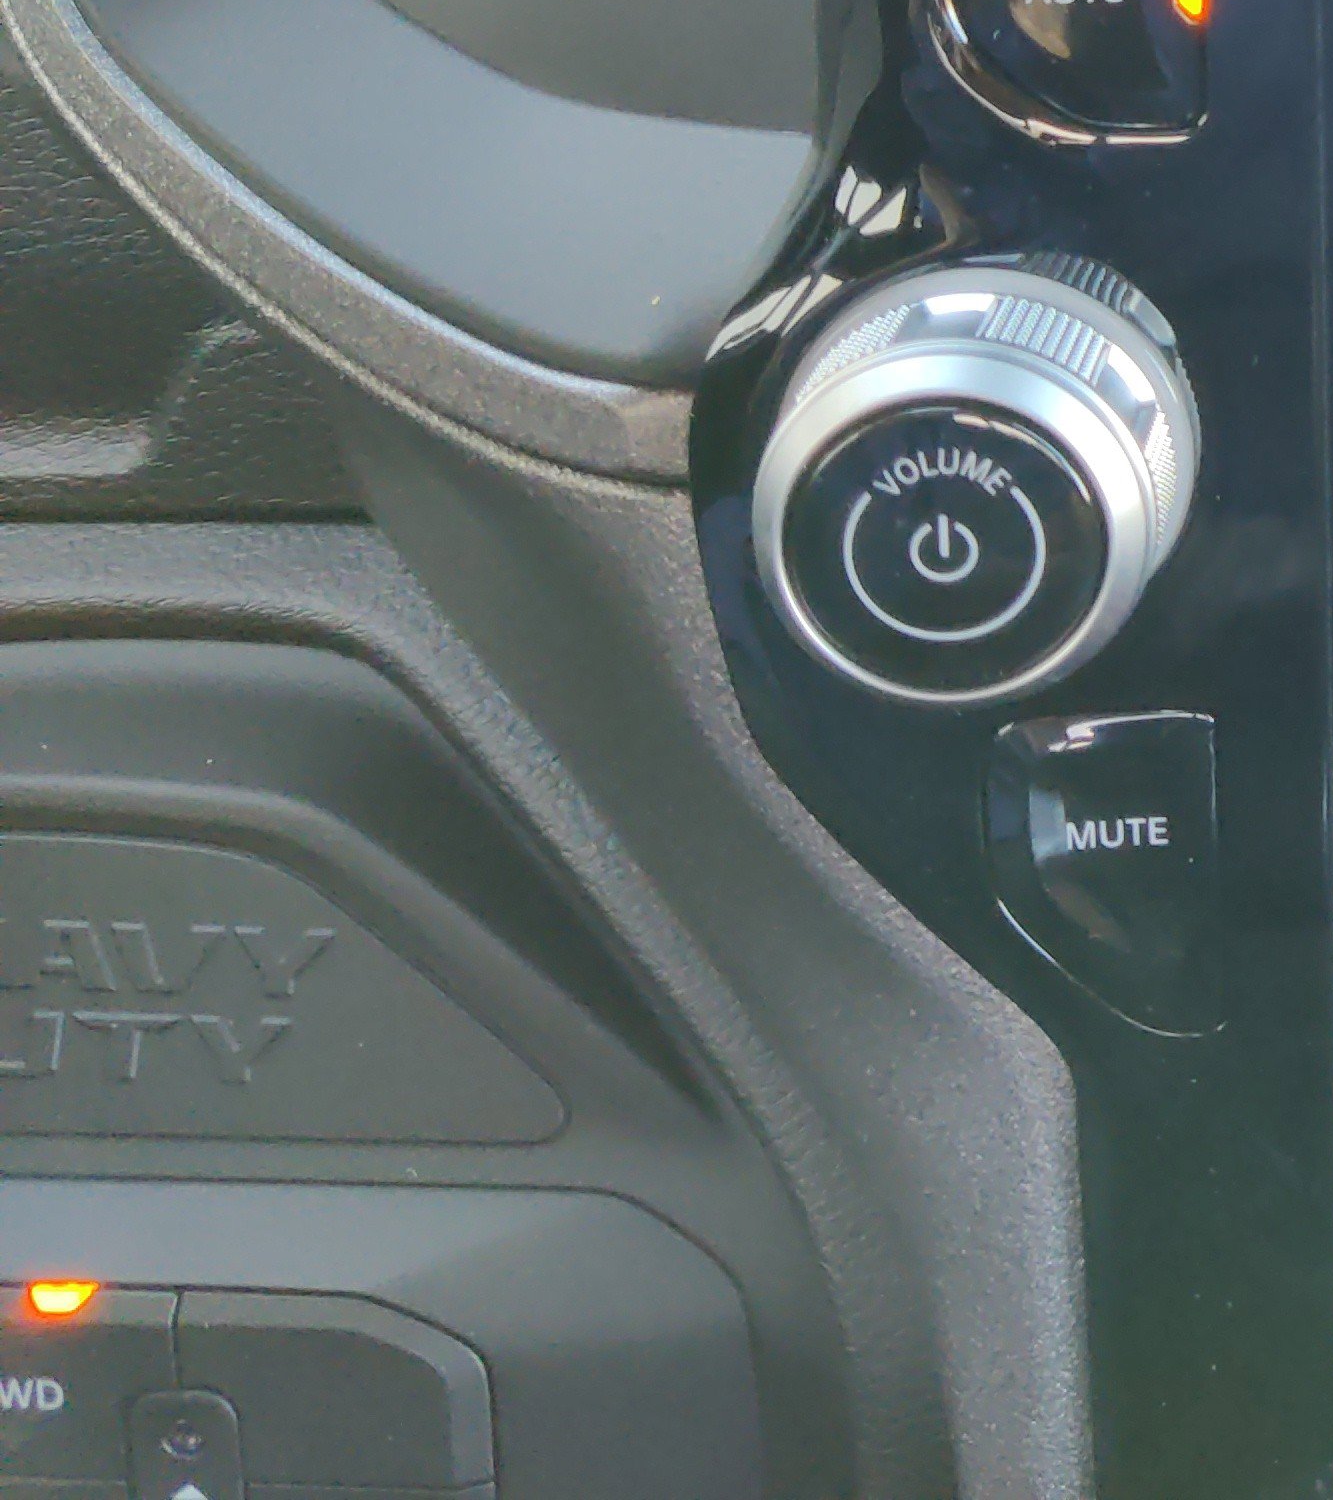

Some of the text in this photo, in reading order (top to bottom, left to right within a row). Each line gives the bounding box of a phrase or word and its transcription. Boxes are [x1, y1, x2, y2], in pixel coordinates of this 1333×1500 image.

[872, 446, 1013, 497] VOLUME
[1066, 816, 1169, 851] MUTE
[0, 918, 337, 997] AVY
